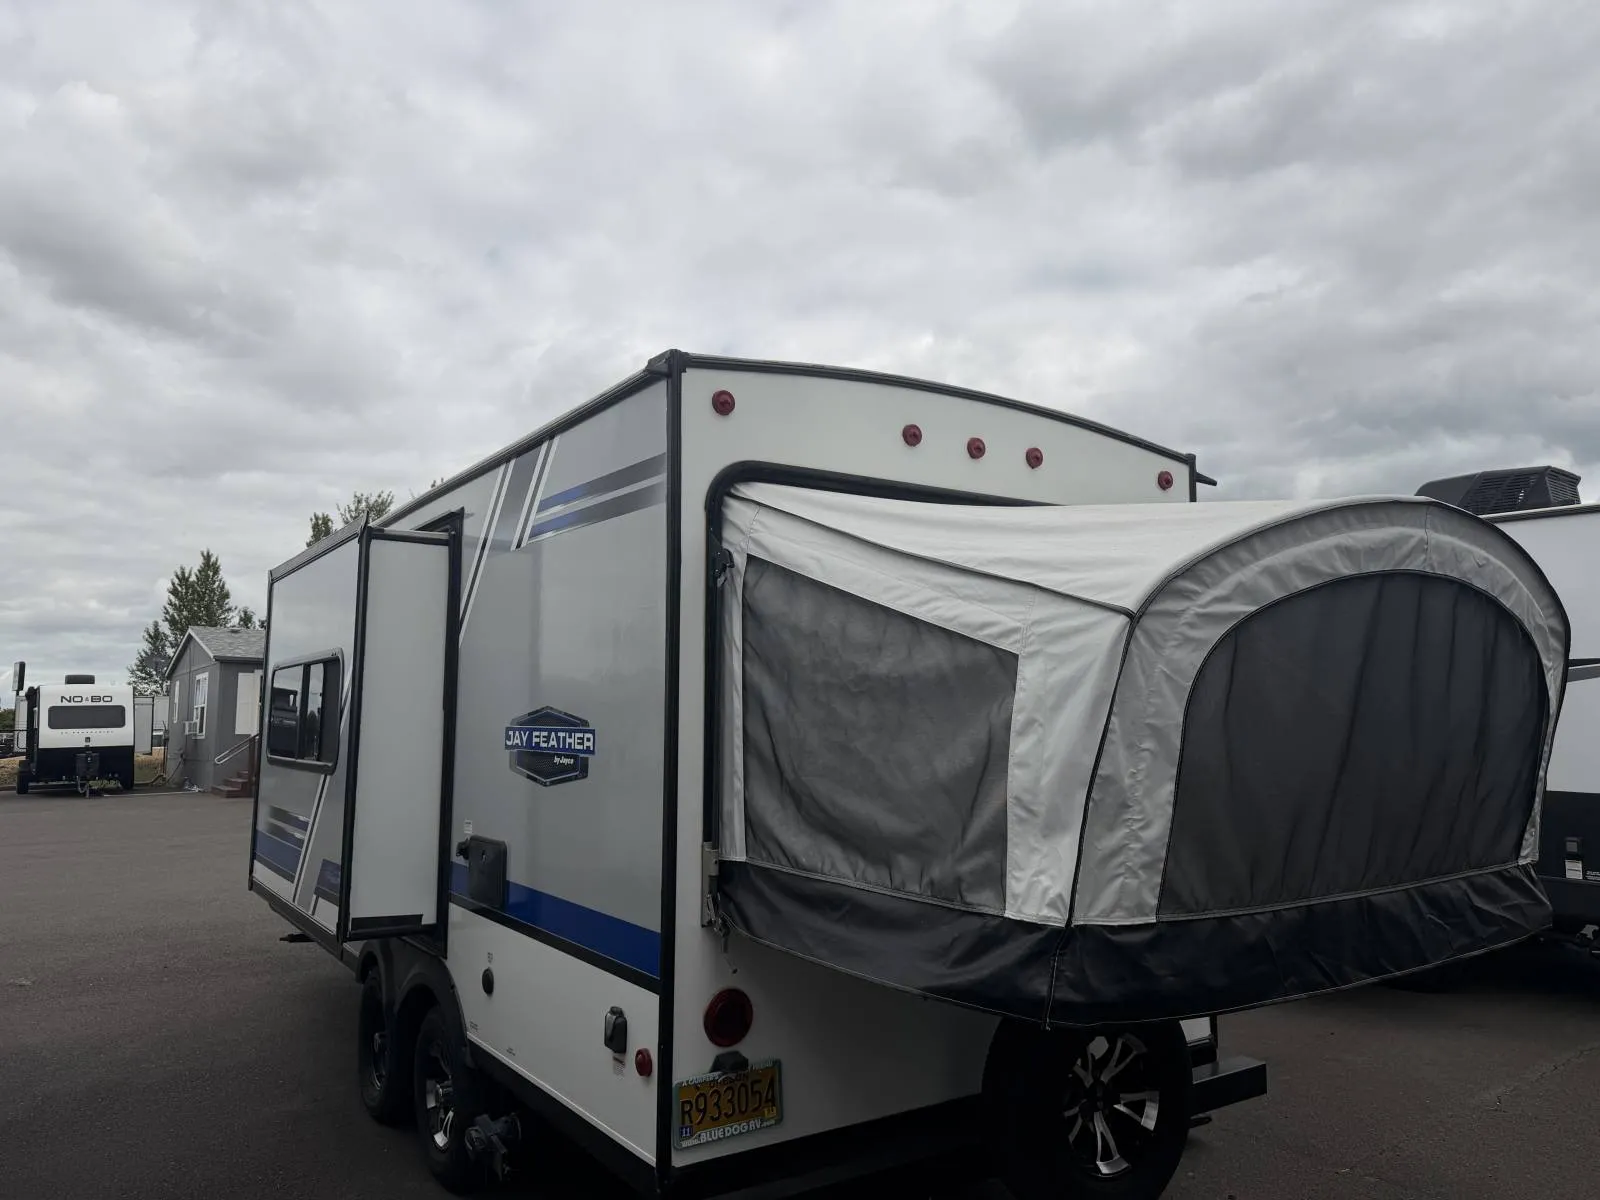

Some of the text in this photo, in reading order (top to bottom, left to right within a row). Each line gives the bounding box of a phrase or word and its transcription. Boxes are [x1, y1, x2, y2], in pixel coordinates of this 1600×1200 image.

[505, 730, 594, 751] JAY FEATHER
[680, 1076, 776, 1126] R933054
